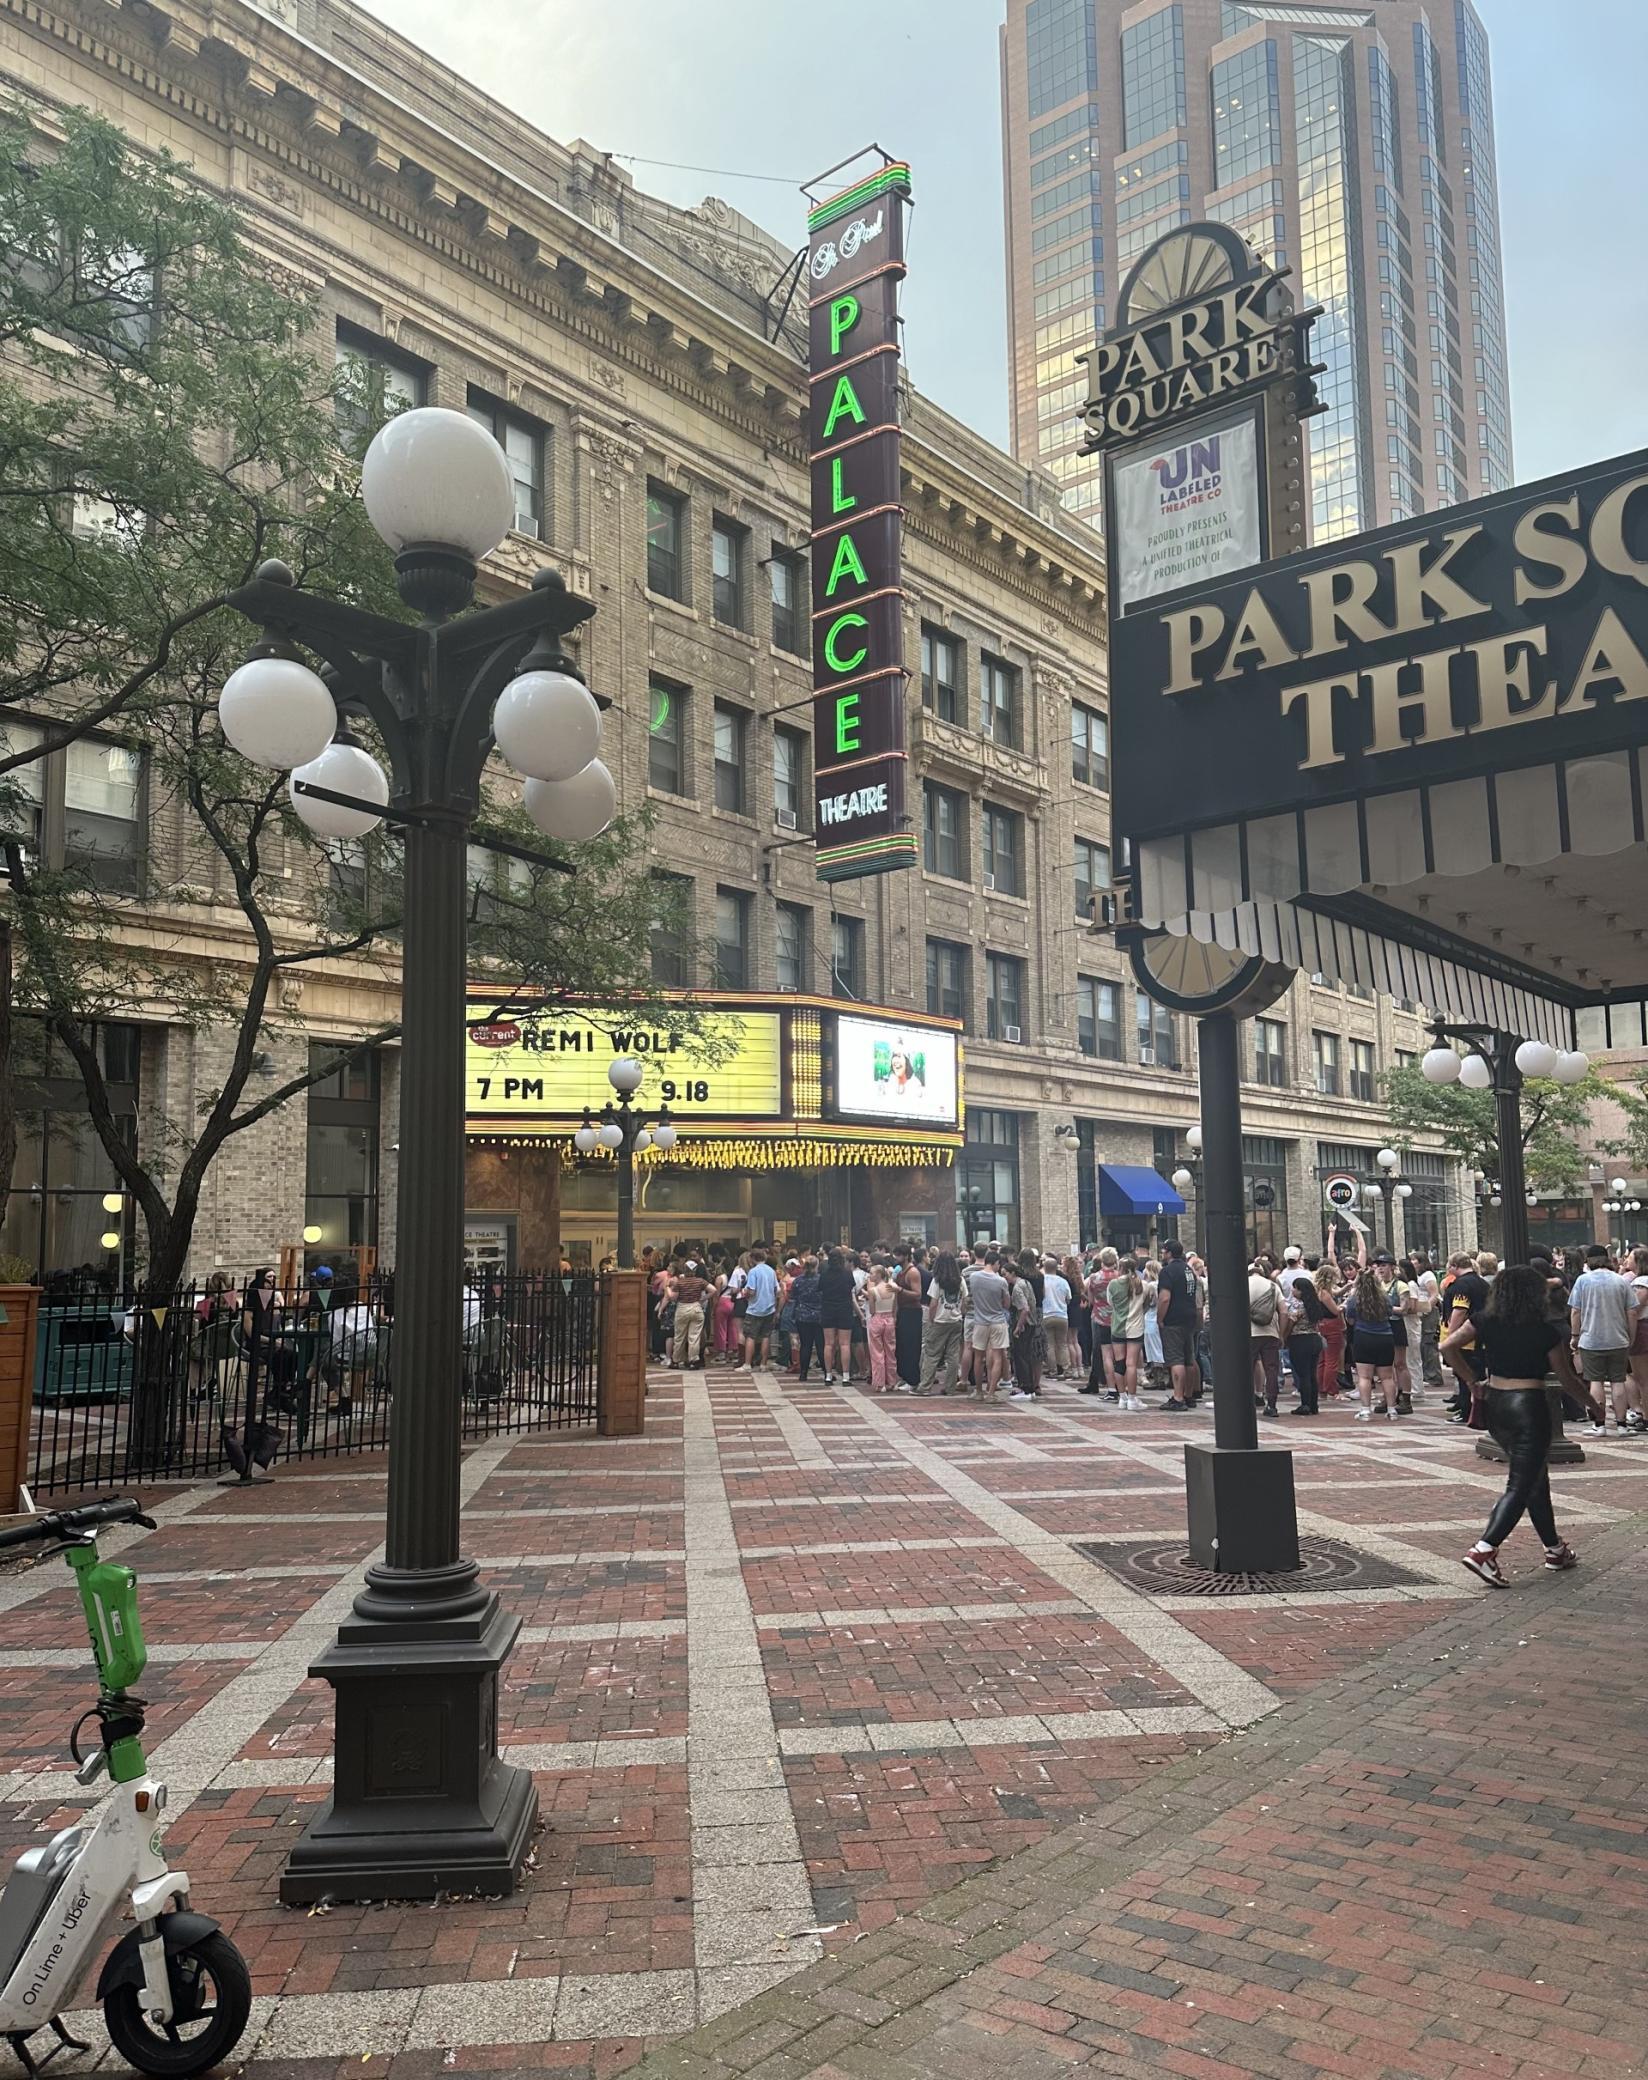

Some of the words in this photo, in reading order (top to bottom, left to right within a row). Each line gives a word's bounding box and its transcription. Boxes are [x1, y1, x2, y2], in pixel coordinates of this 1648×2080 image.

[840, 210, 883, 258] Paul
[1076, 274, 1279, 404] PARK
[1085, 333, 1278, 446] SQUARE
[1151, 435, 1221, 489] UN
[1160, 474, 1222, 505] LABELED
[1161, 494, 1204, 515] THEATRE
[1208, 488, 1222, 500] CO
[823, 294, 868, 754] PALACE
[1147, 527, 1185, 548] PROUDLY
[1187, 511, 1227, 533] PRESENTS
[1142, 556, 1148, 567] A
[1150, 545, 1182, 564] UNIFIED
[1185, 528, 1233, 551] THEATRICAL
[1154, 554, 1208, 580] PRODUCTION
[1160, 523, 1492, 696] PARK
[819, 783, 888, 826] THEATRE
[473, 1030, 516, 1040] current
[522, 1030, 593, 1052] REMI
[611, 1032, 684, 1053] WOLF
[477, 1078, 491, 1099] 7
[504, 1078, 544, 1100] PM
[661, 1080, 709, 1102] 9.18
[1331, 1189, 1350, 1198] afro
[23, 1982, 43, 2005] On
[35, 1944, 63, 1981] Lime
[62, 1891, 91, 1930] Uber
